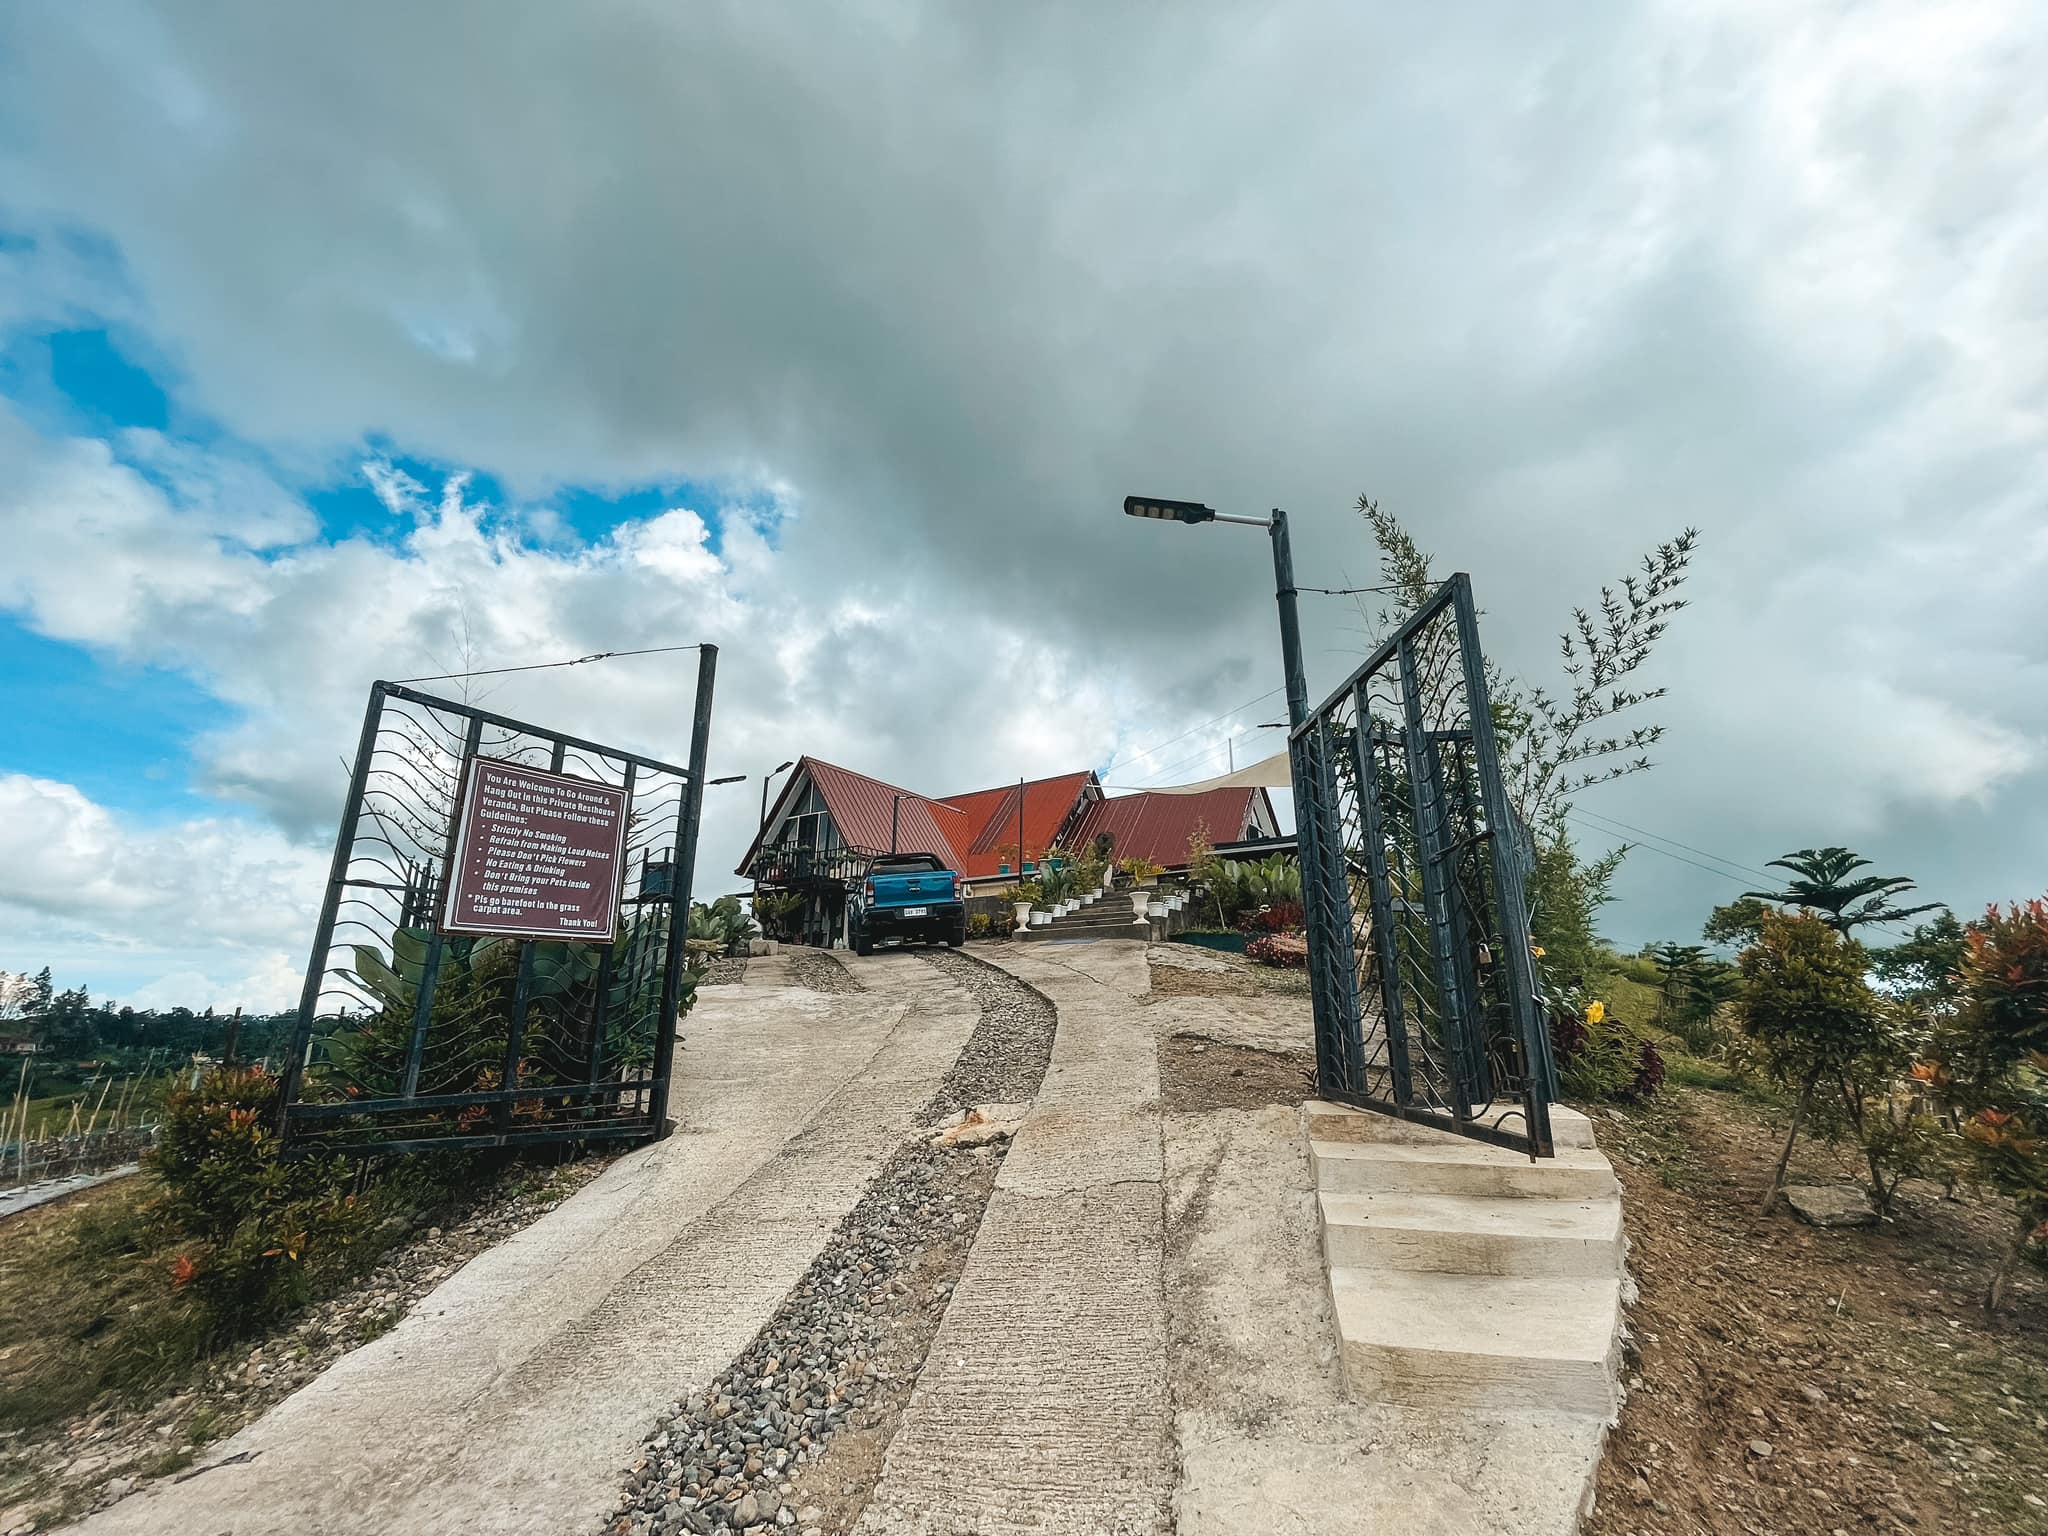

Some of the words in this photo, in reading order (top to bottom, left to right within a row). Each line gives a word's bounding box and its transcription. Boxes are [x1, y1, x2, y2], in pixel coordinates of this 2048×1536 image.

[487, 773, 501, 783] You
[503, 777, 516, 786] Are
[520, 780, 554, 794] Welcome
[557, 788, 565, 796] To
[567, 790, 576, 798] Go
[578, 792, 603, 803] Around
[484, 785, 506, 798] Hang
[508, 790, 521, 799] Out
[533, 795, 547, 804] this
[549, 798, 576, 809] Private
[578, 803, 615, 816] Resthouse
[480, 809, 528, 824] Guidelines:
[483, 797, 518, 812] Veranda,
[520, 804, 534, 814] But
[536, 807, 562, 818] Please
[564, 812, 588, 822] Follow
[589, 816, 608, 826] these
[491, 824, 522, 837] Strictly
[523, 829, 533, 837] No
[535, 831, 567, 844] Smoking
[490, 835, 519, 847] Refrain
[520, 840, 539, 849] from
[540, 843, 567, 855] Making
[568, 847, 585, 856] Loud
[586, 849, 610, 859] Noises
[488, 847, 516, 858] Please
[517, 851, 540, 861] Don't
[540, 854, 557, 863] Pick
[558, 856, 586, 867] Flowers
[486, 858, 497, 867] No
[499, 860, 524, 872] Eating
[534, 865, 565, 877] Drinking
[483, 882, 499, 891] this
[500, 886, 538, 895] premises
[484, 870, 508, 880] Don't
[509, 873, 530, 884] Bring
[532, 877, 549, 885] your
[550, 878, 567, 887] Pets
[568, 880, 590, 889] inside
[473, 905, 501, 914] carpet
[474, 895, 488, 903] Pls
[490, 898, 500, 906] go
[502, 897, 536, 908] barefoot
[546, 902, 559, 910] the
[560, 904, 580, 912] grass
[560, 918, 581, 926] Thank
